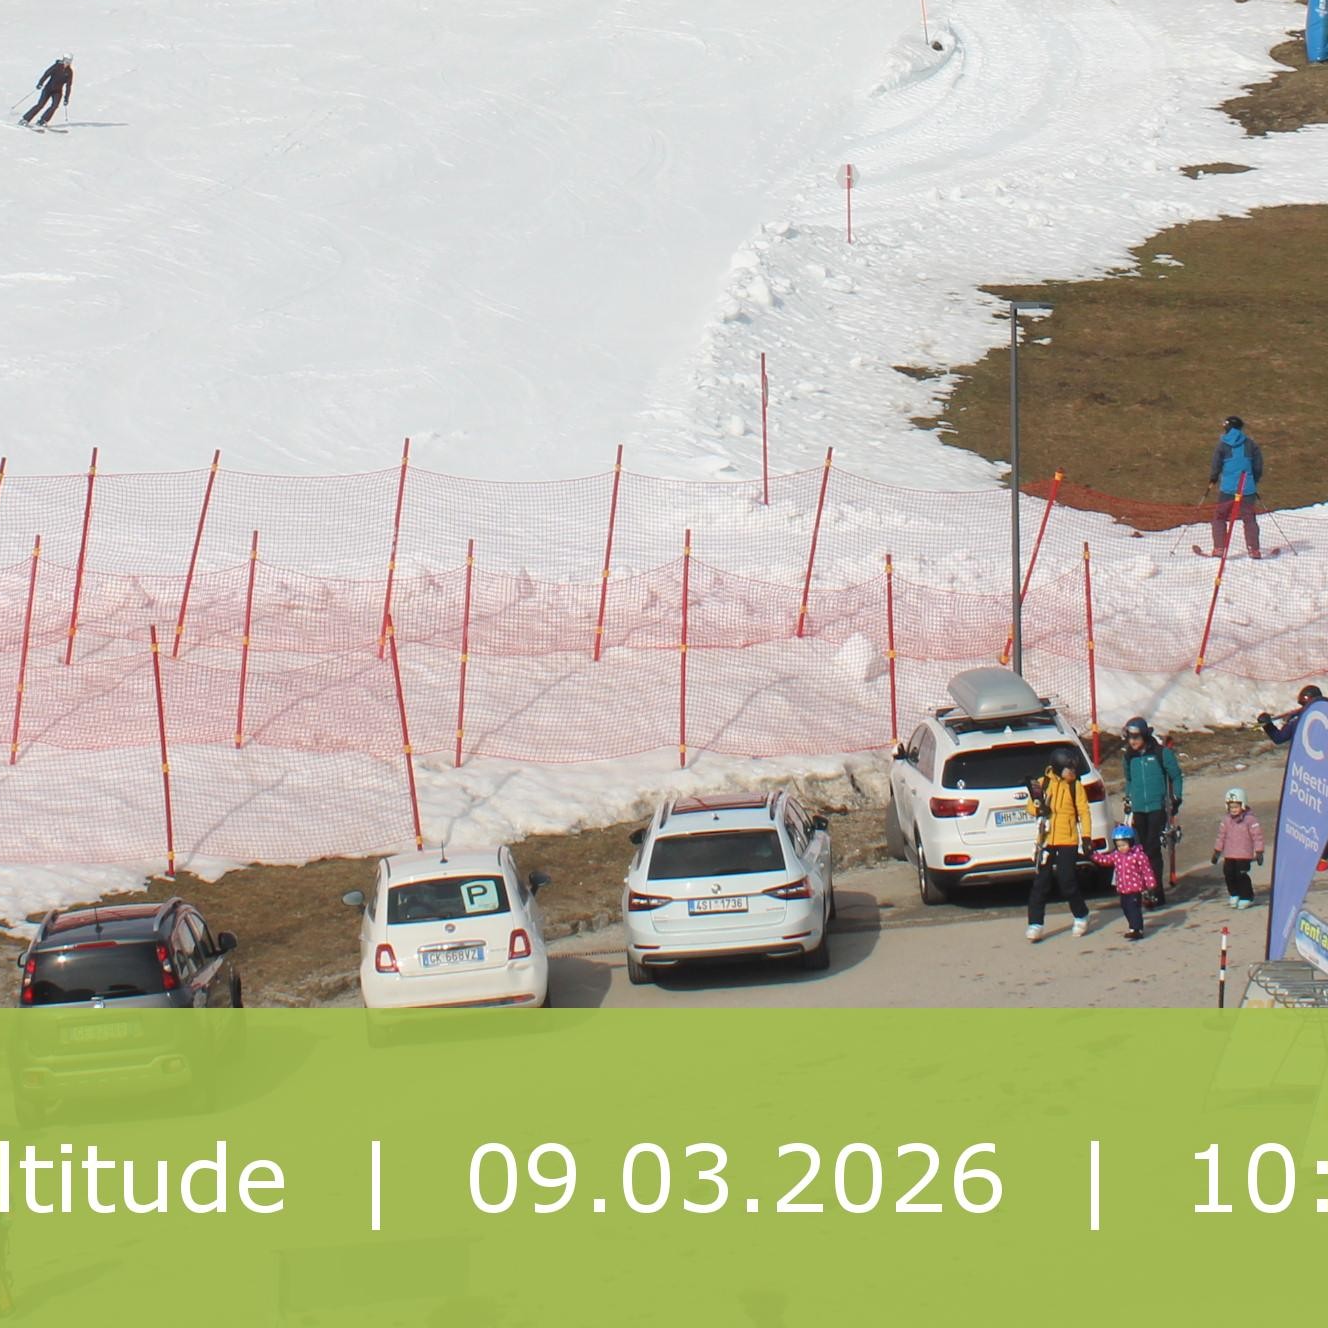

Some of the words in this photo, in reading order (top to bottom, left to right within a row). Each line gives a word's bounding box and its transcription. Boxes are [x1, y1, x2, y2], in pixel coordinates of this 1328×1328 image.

[1289, 780, 1323, 814] Point
[1285, 823, 1320, 853] snowpro
[466, 884, 488, 905] P
[1299, 918, 1321, 942] rent
